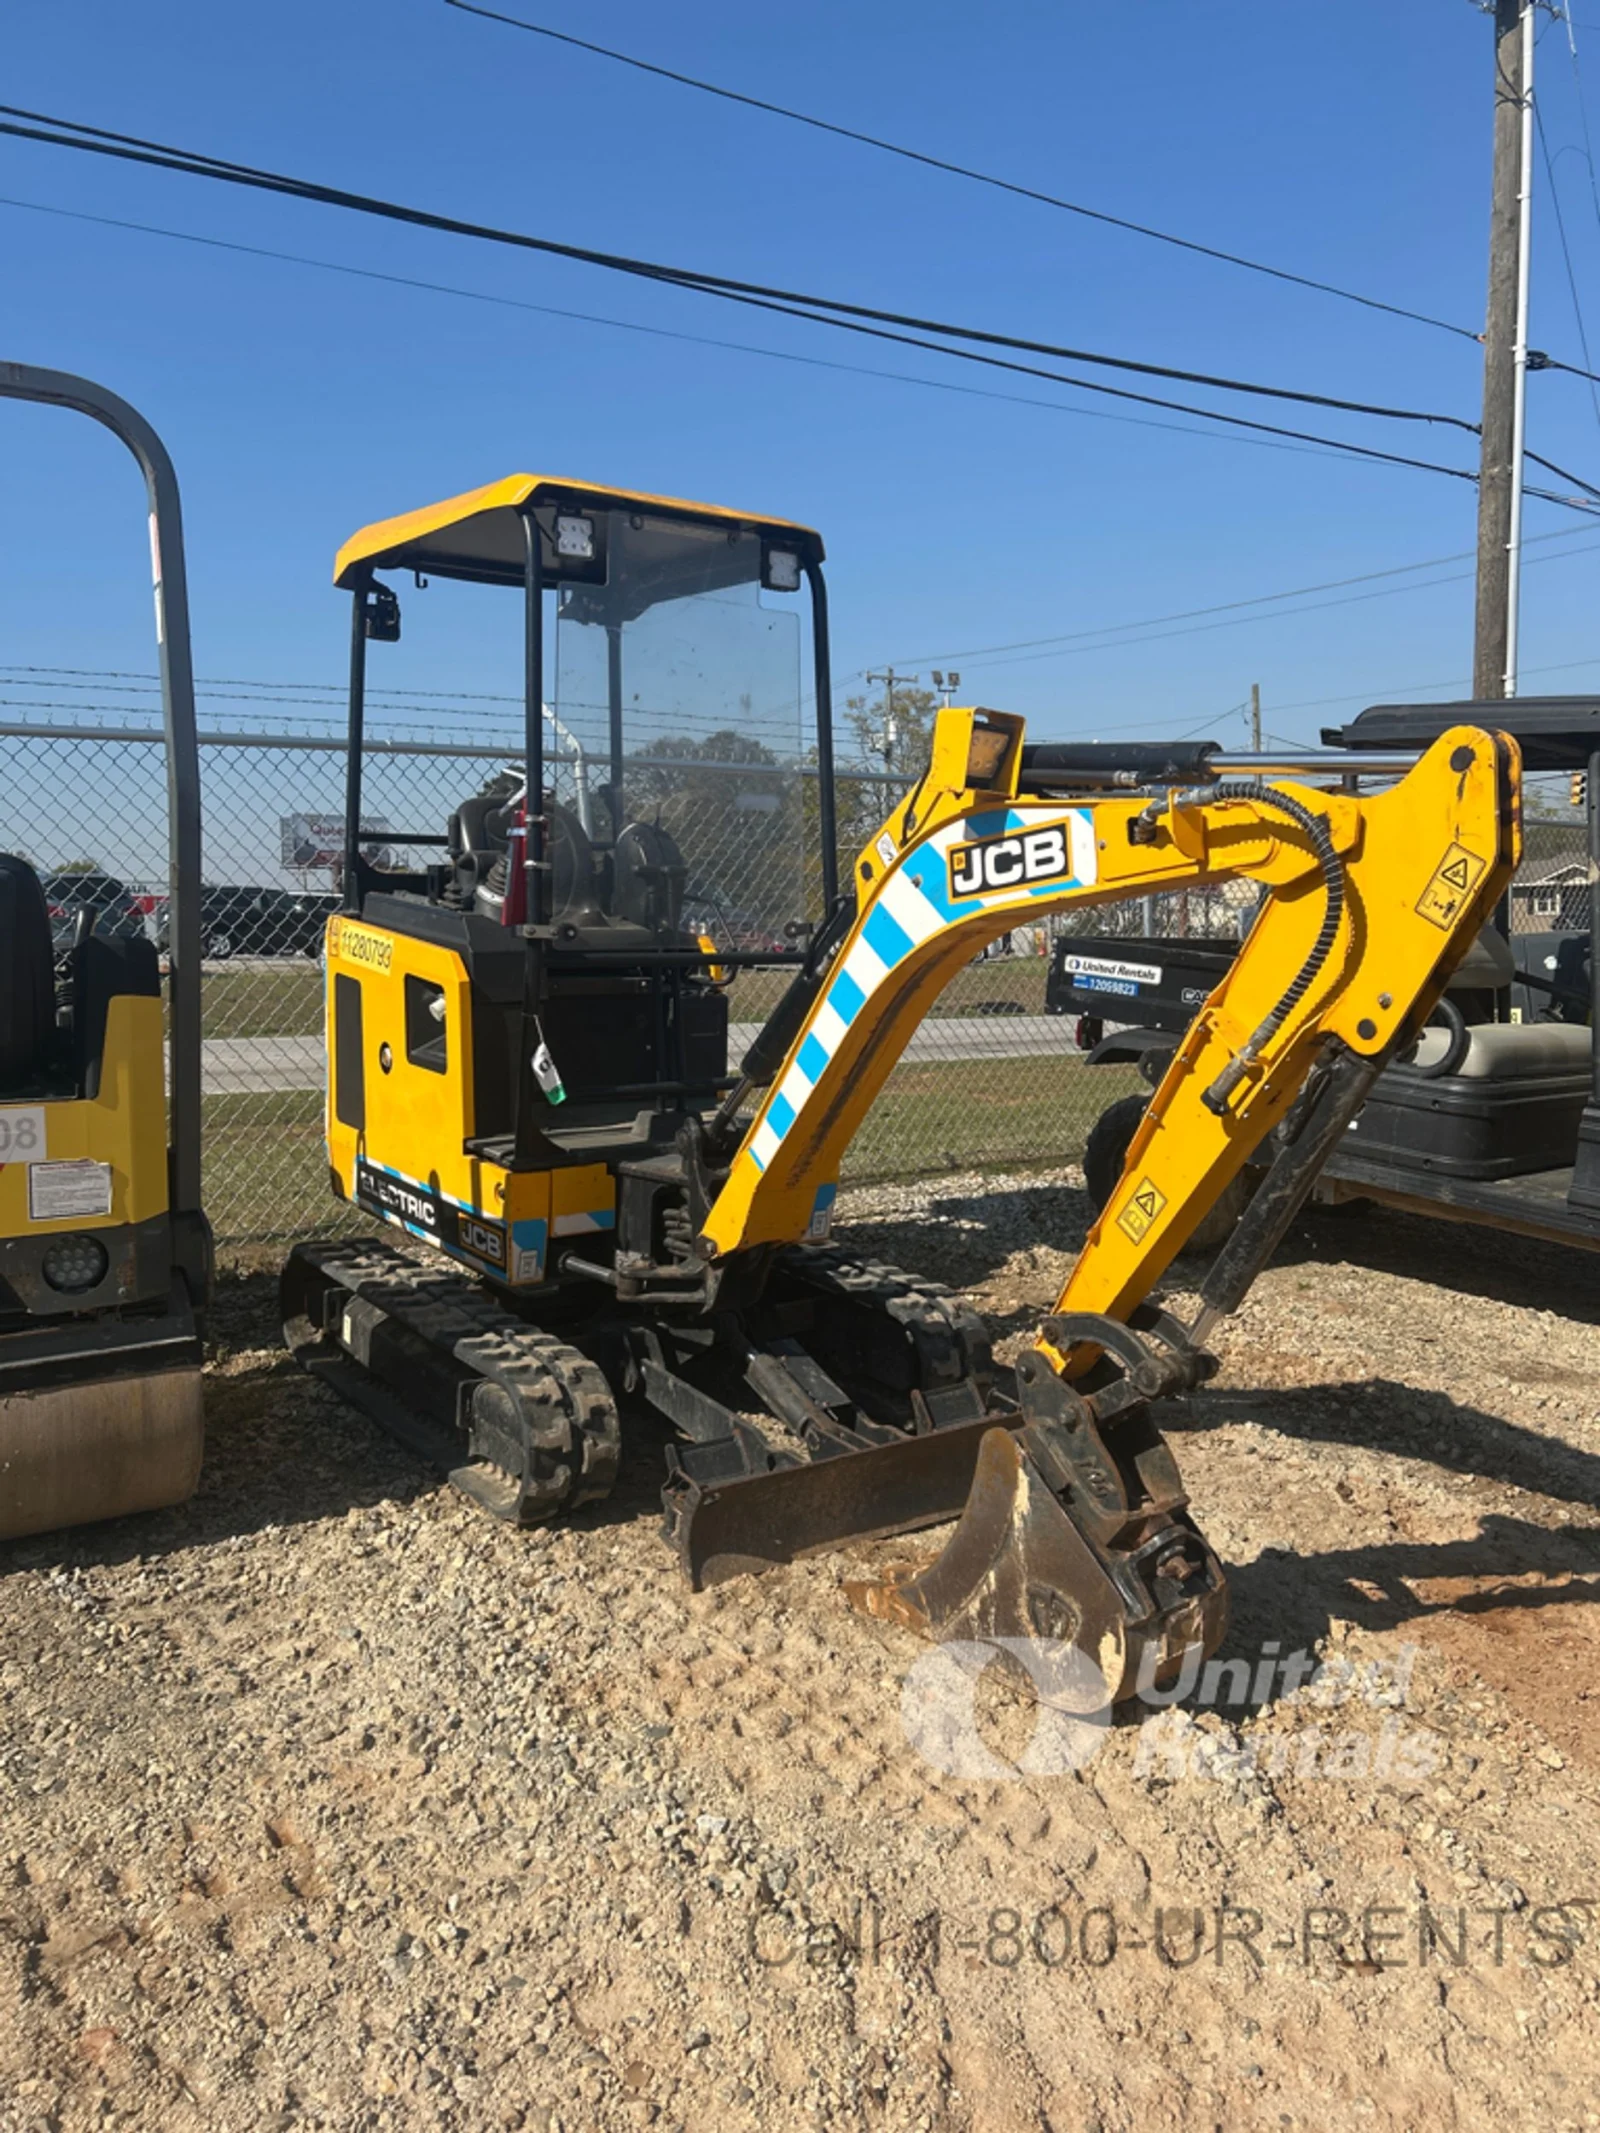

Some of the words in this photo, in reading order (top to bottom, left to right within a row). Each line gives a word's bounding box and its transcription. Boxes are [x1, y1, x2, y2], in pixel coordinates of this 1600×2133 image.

[953, 830, 1067, 893] JCB
[342, 930, 393, 969] 11280793
[1082, 960, 1117, 974] United
[1117, 964, 1156, 981] Rentals
[360, 1170, 436, 1227] ELECTRIC
[461, 1222, 501, 1259] JCB
